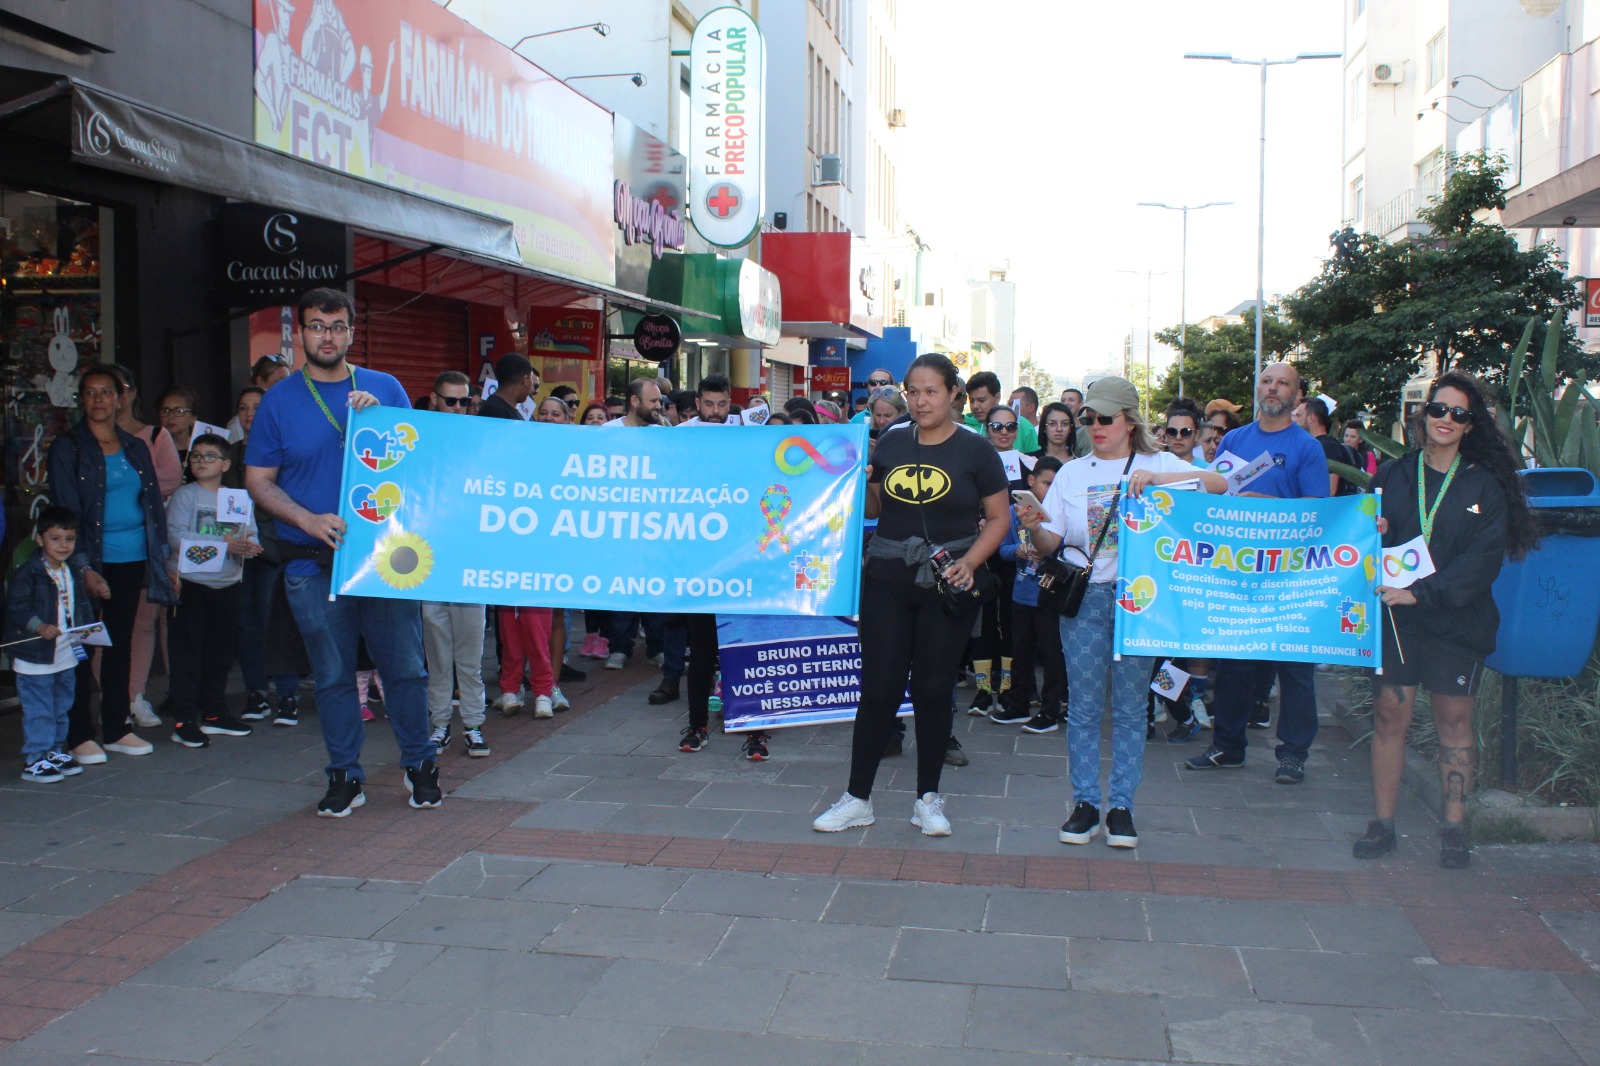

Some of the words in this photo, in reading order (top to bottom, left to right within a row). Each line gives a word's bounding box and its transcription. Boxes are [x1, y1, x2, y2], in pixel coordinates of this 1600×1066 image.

[289, 56, 361, 120] FARMÁCIAS
[401, 22, 498, 145] FARMÁCIA
[501, 83, 524, 157] DO
[702, 29, 721, 175] FARMÁCIA
[725, 26, 748, 175] PREÇOPOPULAR
[227, 260, 338, 282] CacauShow
[560, 453, 657, 480] ABRIL
[463, 475, 507, 497] MÊS
[513, 482, 544, 499] DA
[549, 482, 749, 508] CONSCIENTIZAÇÃO
[479, 504, 538, 534] DO
[550, 507, 729, 541] AUTISMO
[1206, 506, 1297, 524] CAMINHADA
[1300, 511, 1317, 523] DE
[1193, 521, 1323, 543] CONSCIENTIZAÇÃO
[1155, 536, 1360, 573] CAPACITISMO
[463, 568, 574, 593] RESPEITO
[581, 573, 602, 594] O
[609, 574, 666, 596] ANO
[673, 577, 753, 598] TODO!
[1171, 569, 1237, 589] Capacitismo
[1240, 577, 1248, 588] é
[1251, 580, 1258, 589] a
[1260, 574, 1338, 592] discriminação
[1168, 583, 1202, 597] contra
[1205, 589, 1249, 604] pessoas
[1252, 592, 1274, 602] com
[1278, 586, 1342, 601] deficiência,
[1182, 598, 1205, 612] seja
[1207, 602, 1227, 617] por
[1229, 602, 1257, 614] meio
[1260, 601, 1275, 613] de
[1279, 598, 1329, 612] atitudes,
[1201, 626, 1215, 635] ou
[1217, 624, 1272, 636] barreiras
[1207, 612, 1307, 627] comportamentos,
[757, 645, 812, 662] BRUNO
[1123, 637, 1181, 651] QUALQUER
[1183, 640, 1268, 654] DISCRIMINAÇÃO
[1271, 640, 1277, 651] É
[1279, 643, 1309, 654] CRIME
[1311, 645, 1357, 657] DENUNCIE
[1358, 648, 1372, 658] 190
[744, 663, 798, 679] NOSSO
[802, 658, 862, 674] ETERNO
[731, 680, 774, 697] VOCÊ
[778, 675, 859, 692] CONTINUA
[761, 695, 812, 711] NESSA
